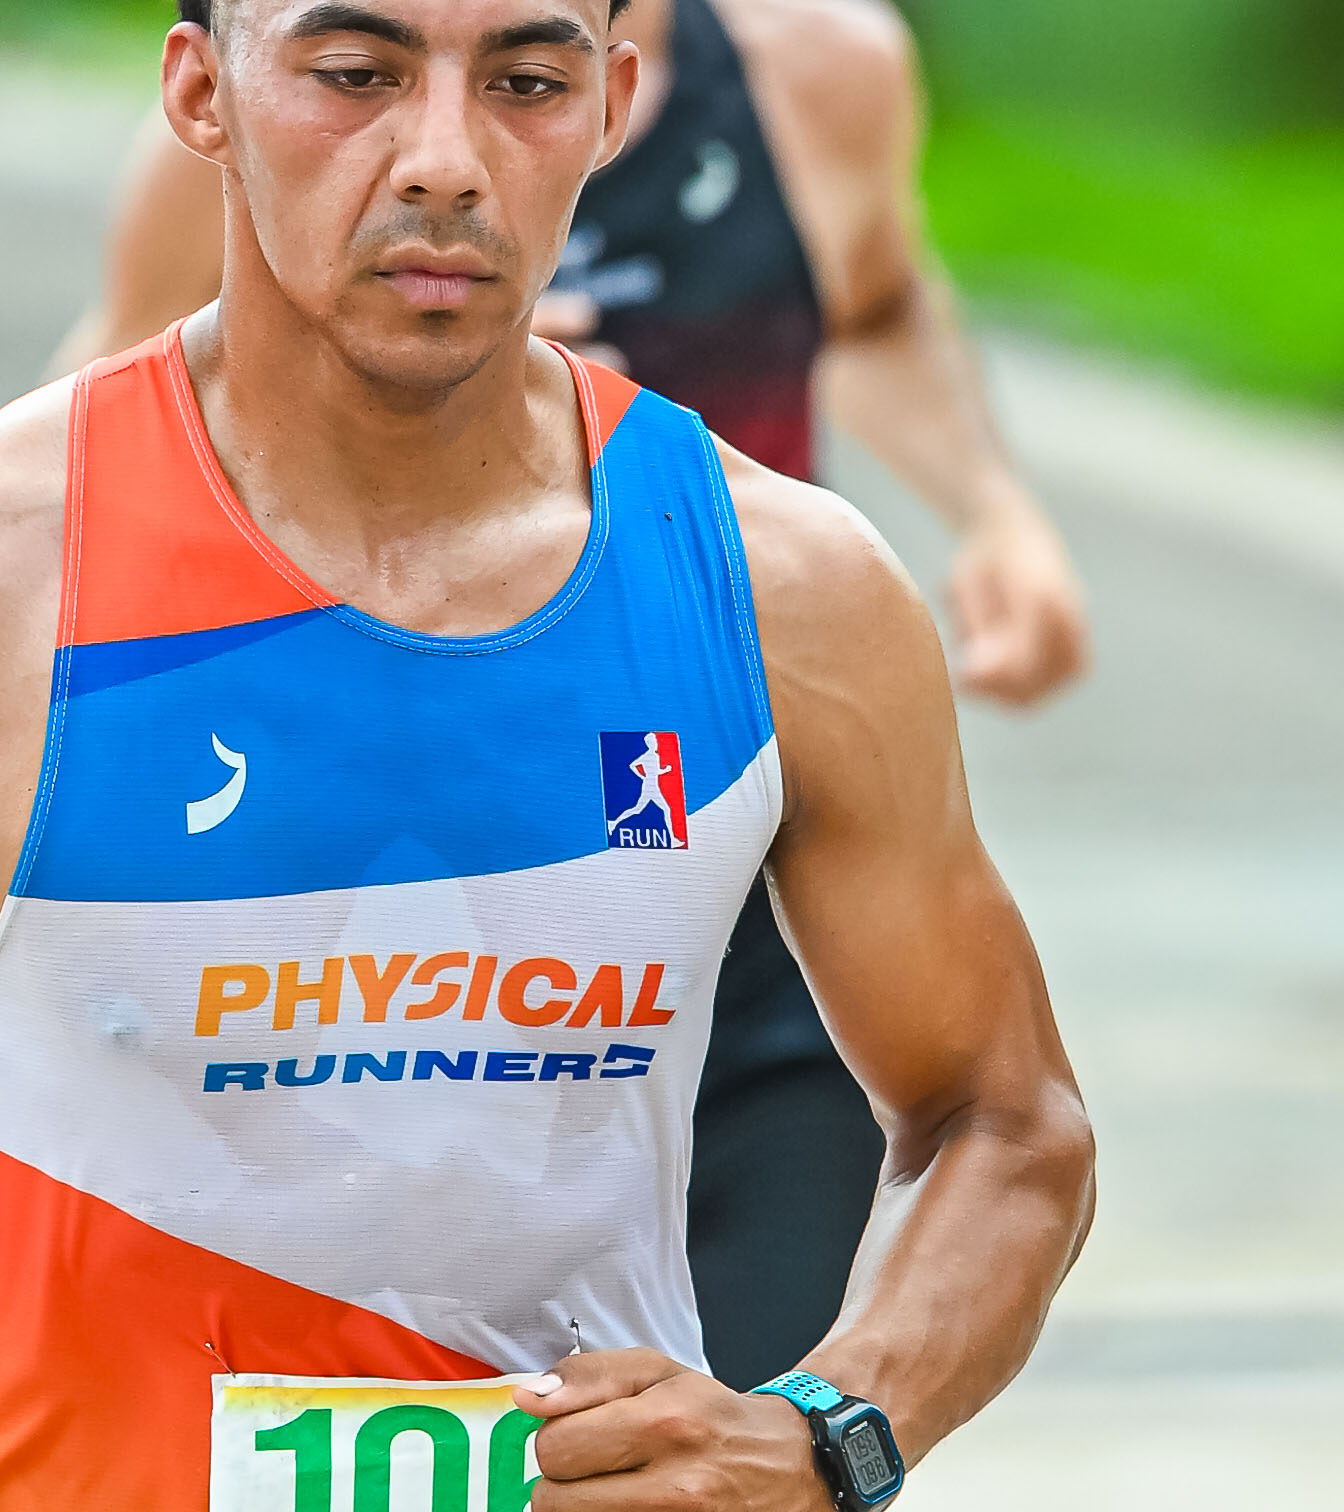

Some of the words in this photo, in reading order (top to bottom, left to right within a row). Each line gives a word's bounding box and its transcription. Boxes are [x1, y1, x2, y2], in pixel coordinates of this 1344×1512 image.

[619, 828, 668, 847] RUN
[194, 951, 676, 1036] PHYSICAL
[203, 1043, 656, 1093] RUNNERS
